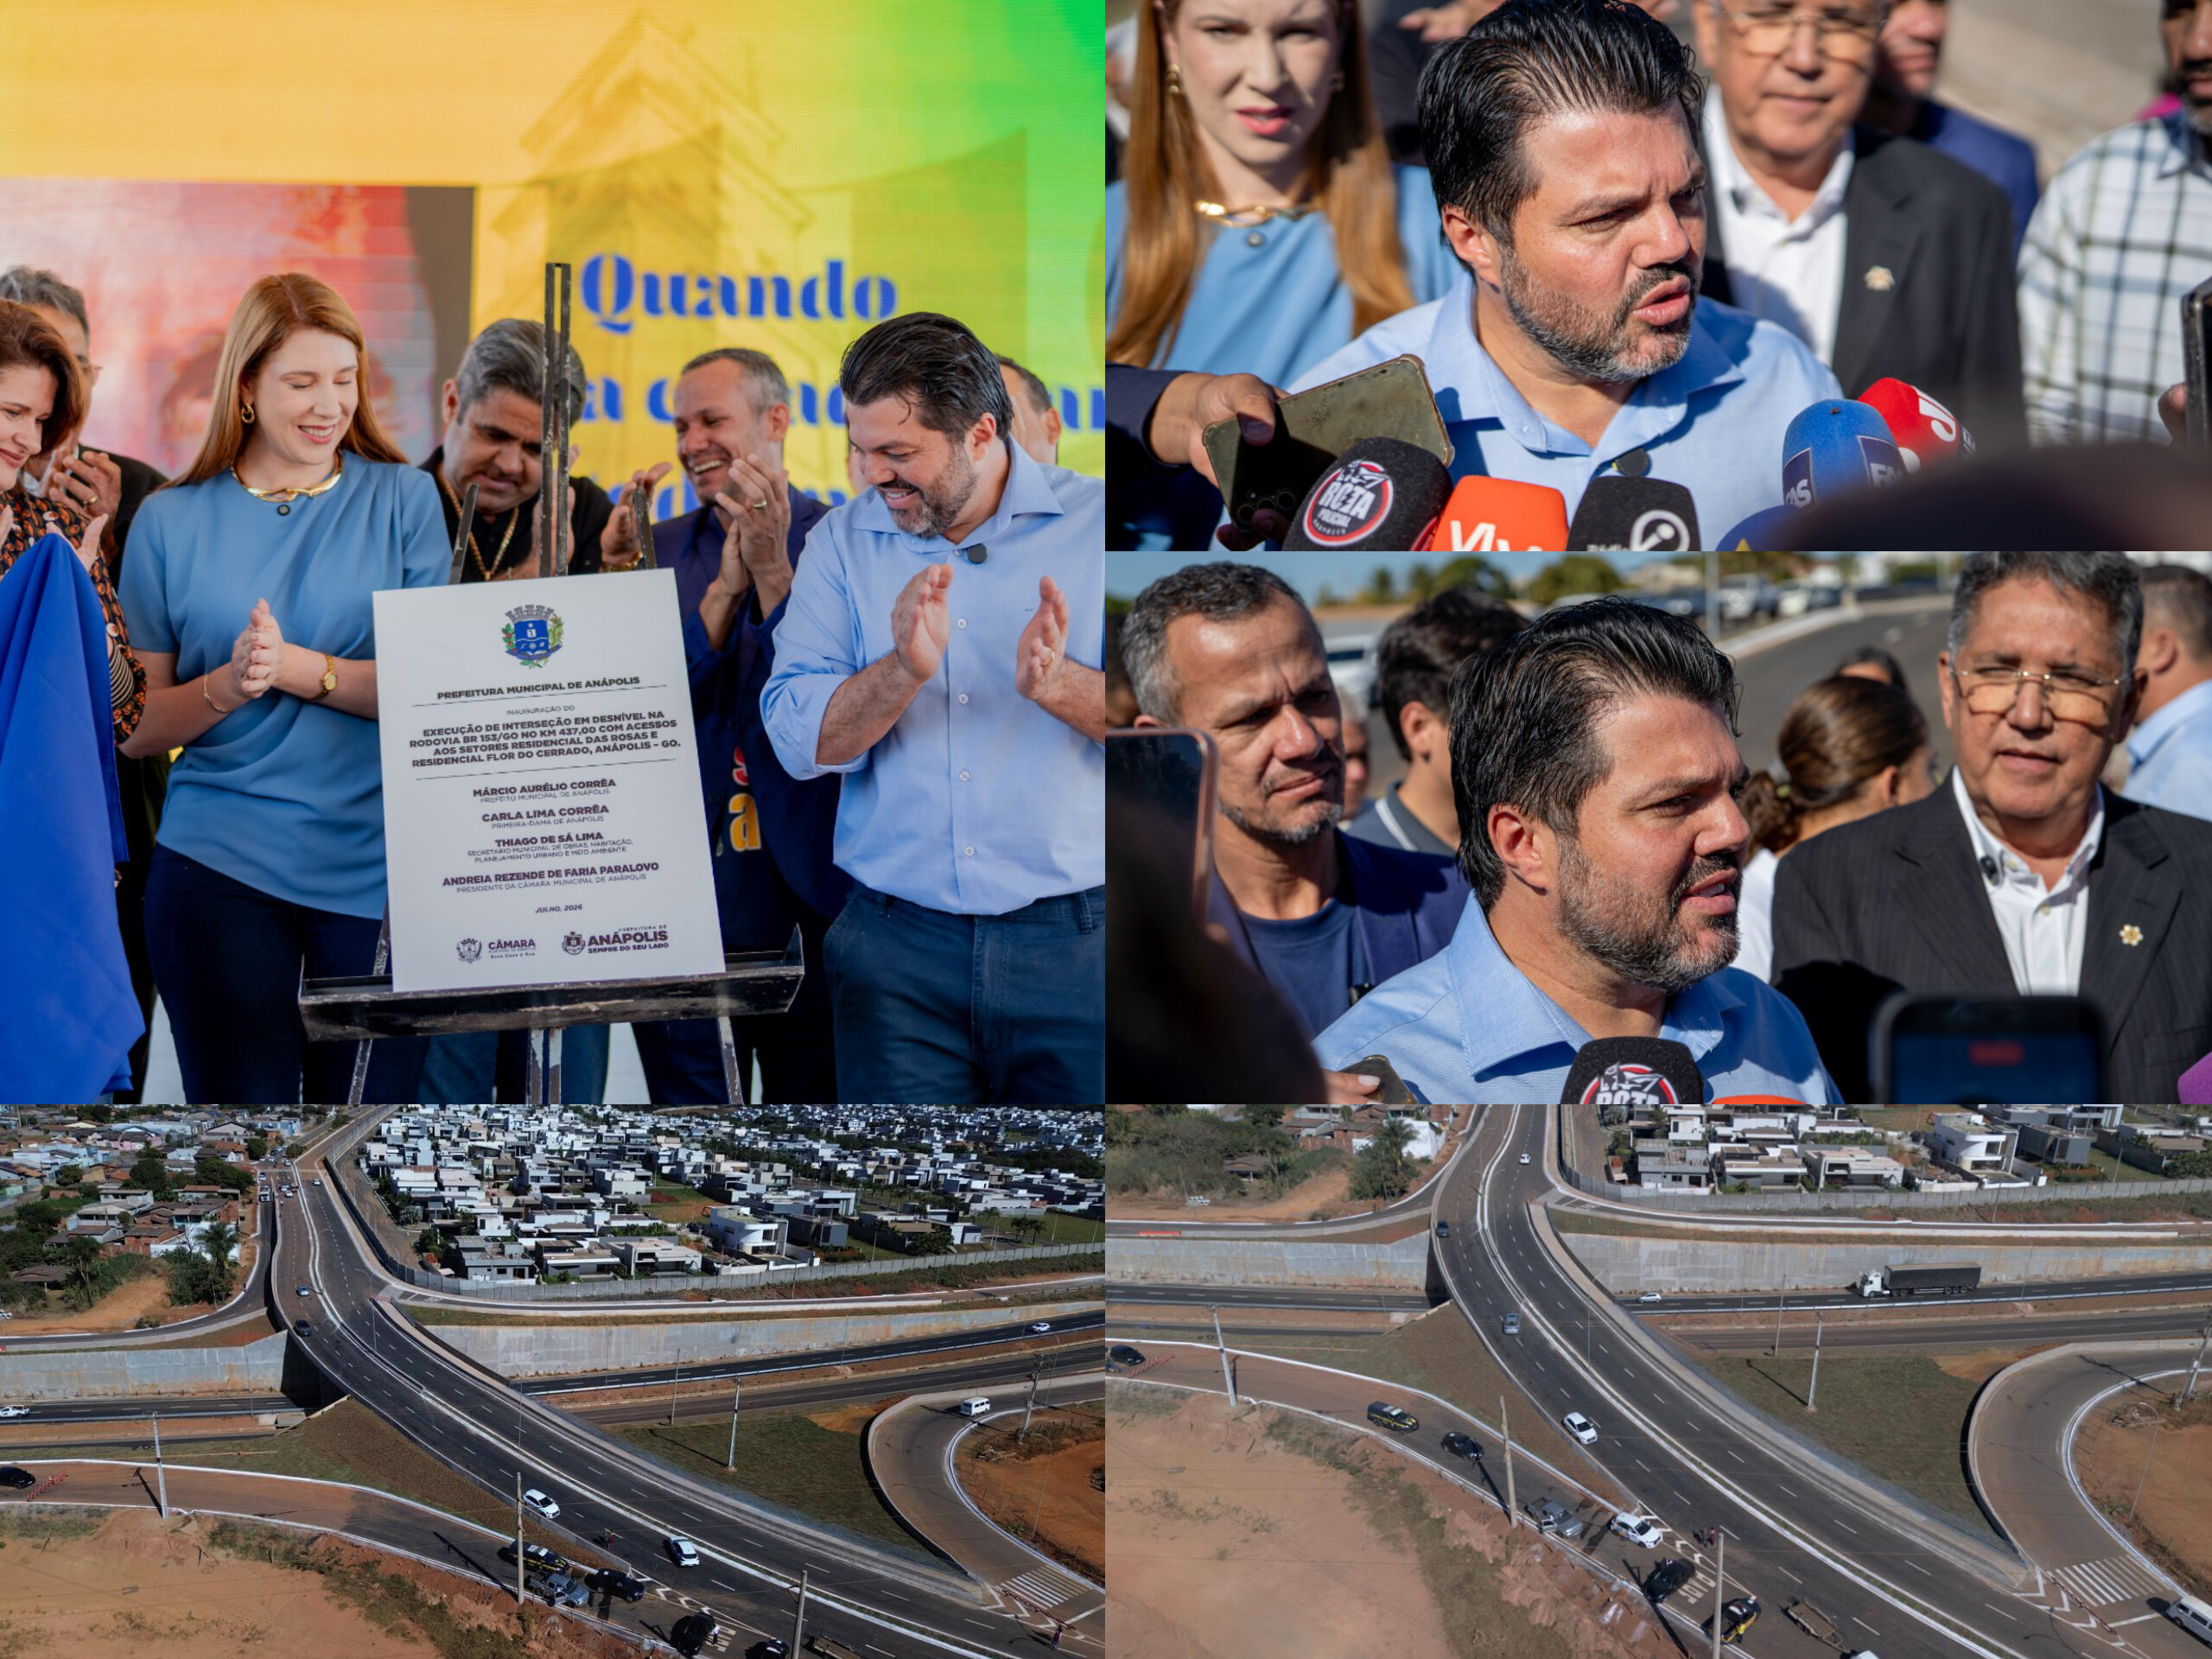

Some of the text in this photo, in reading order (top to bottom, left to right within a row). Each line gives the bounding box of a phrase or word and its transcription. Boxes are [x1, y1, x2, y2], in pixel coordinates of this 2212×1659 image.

[581, 254, 898, 335] Quando
[438, 688, 505, 699] PREFEITURA
[507, 683, 566, 693] MUNICIPAL
[585, 677, 640, 687] ANÁPOLIS
[505, 705, 559, 716] INAUGURAÇÃO
[423, 711, 665, 737] EXECUÇÃO DE INTERSEÇÃO EM DESNÍVEL NA
[410, 720, 677, 748] RODOVIA BR 153/GO NO KM 437,00 COM ACESSOS
[412, 754, 485, 767] RESIDENCIAL
[486, 752, 515, 761] FLOR
[537, 747, 593, 758] CERRADO,
[595, 741, 652, 753] ANÁPOLIS
[662, 740, 681, 748] GO.
[434, 747, 457, 756] AOS
[459, 743, 509, 753] SETORES
[512, 736, 583, 749] RESIDENCIAL
[585, 734, 608, 744] DAS
[611, 732, 648, 743] ROSAS
[473, 779, 617, 798] MÁRCIO AURÉLIO CORRÊA
[482, 806, 610, 823] CARLA LIMA CORRÊA
[495, 831, 604, 848] THIAGO DE SÁ LIMA
[443, 875, 493, 886] ANDREIA
[494, 871, 545, 881] REZENDE
[564, 868, 598, 878] FARIA
[600, 863, 659, 875] PARALOVO
[535, 905, 563, 914] JULHO,
[488, 938, 537, 950] CÂMARA
[588, 931, 669, 947] ANÁPOLIS
[588, 945, 619, 954] SEMPRE
